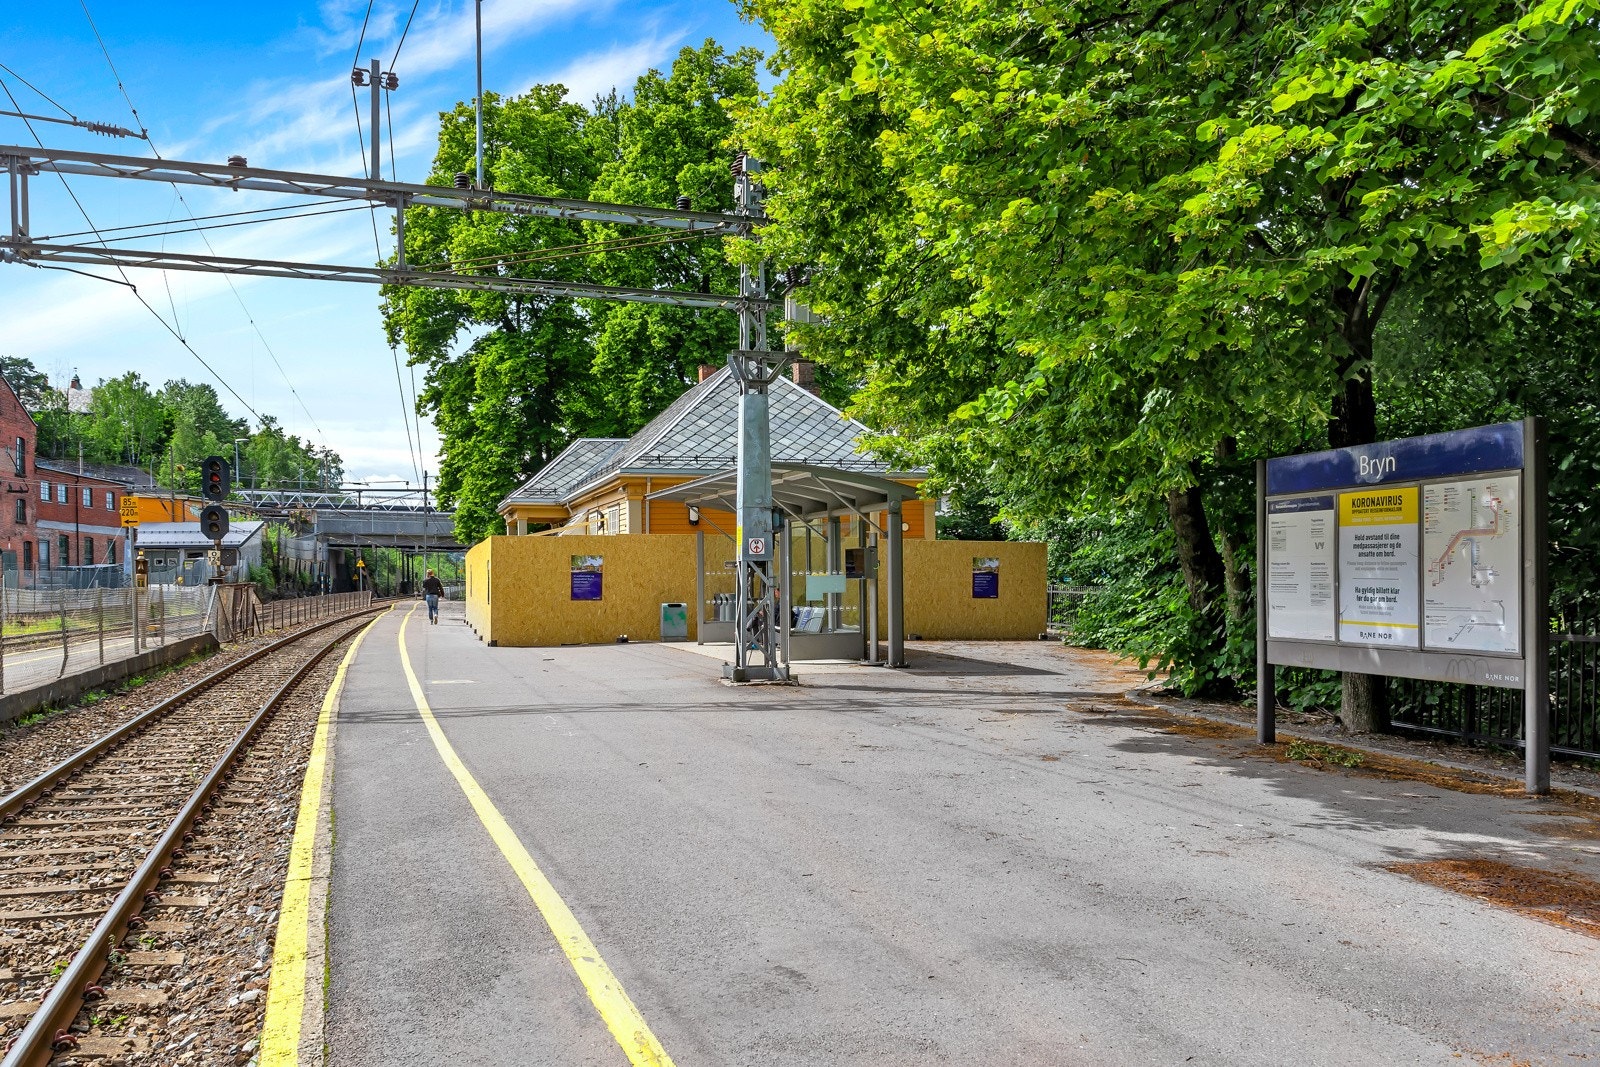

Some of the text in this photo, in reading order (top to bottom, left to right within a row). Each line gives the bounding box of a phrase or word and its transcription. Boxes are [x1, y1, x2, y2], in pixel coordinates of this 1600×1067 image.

[1360, 455, 1396, 479] Bryn
[1352, 495, 1403, 508] KORONAVIRUS
[1362, 587, 1375, 596] gyldig
[1486, 673, 1502, 681] BANE
